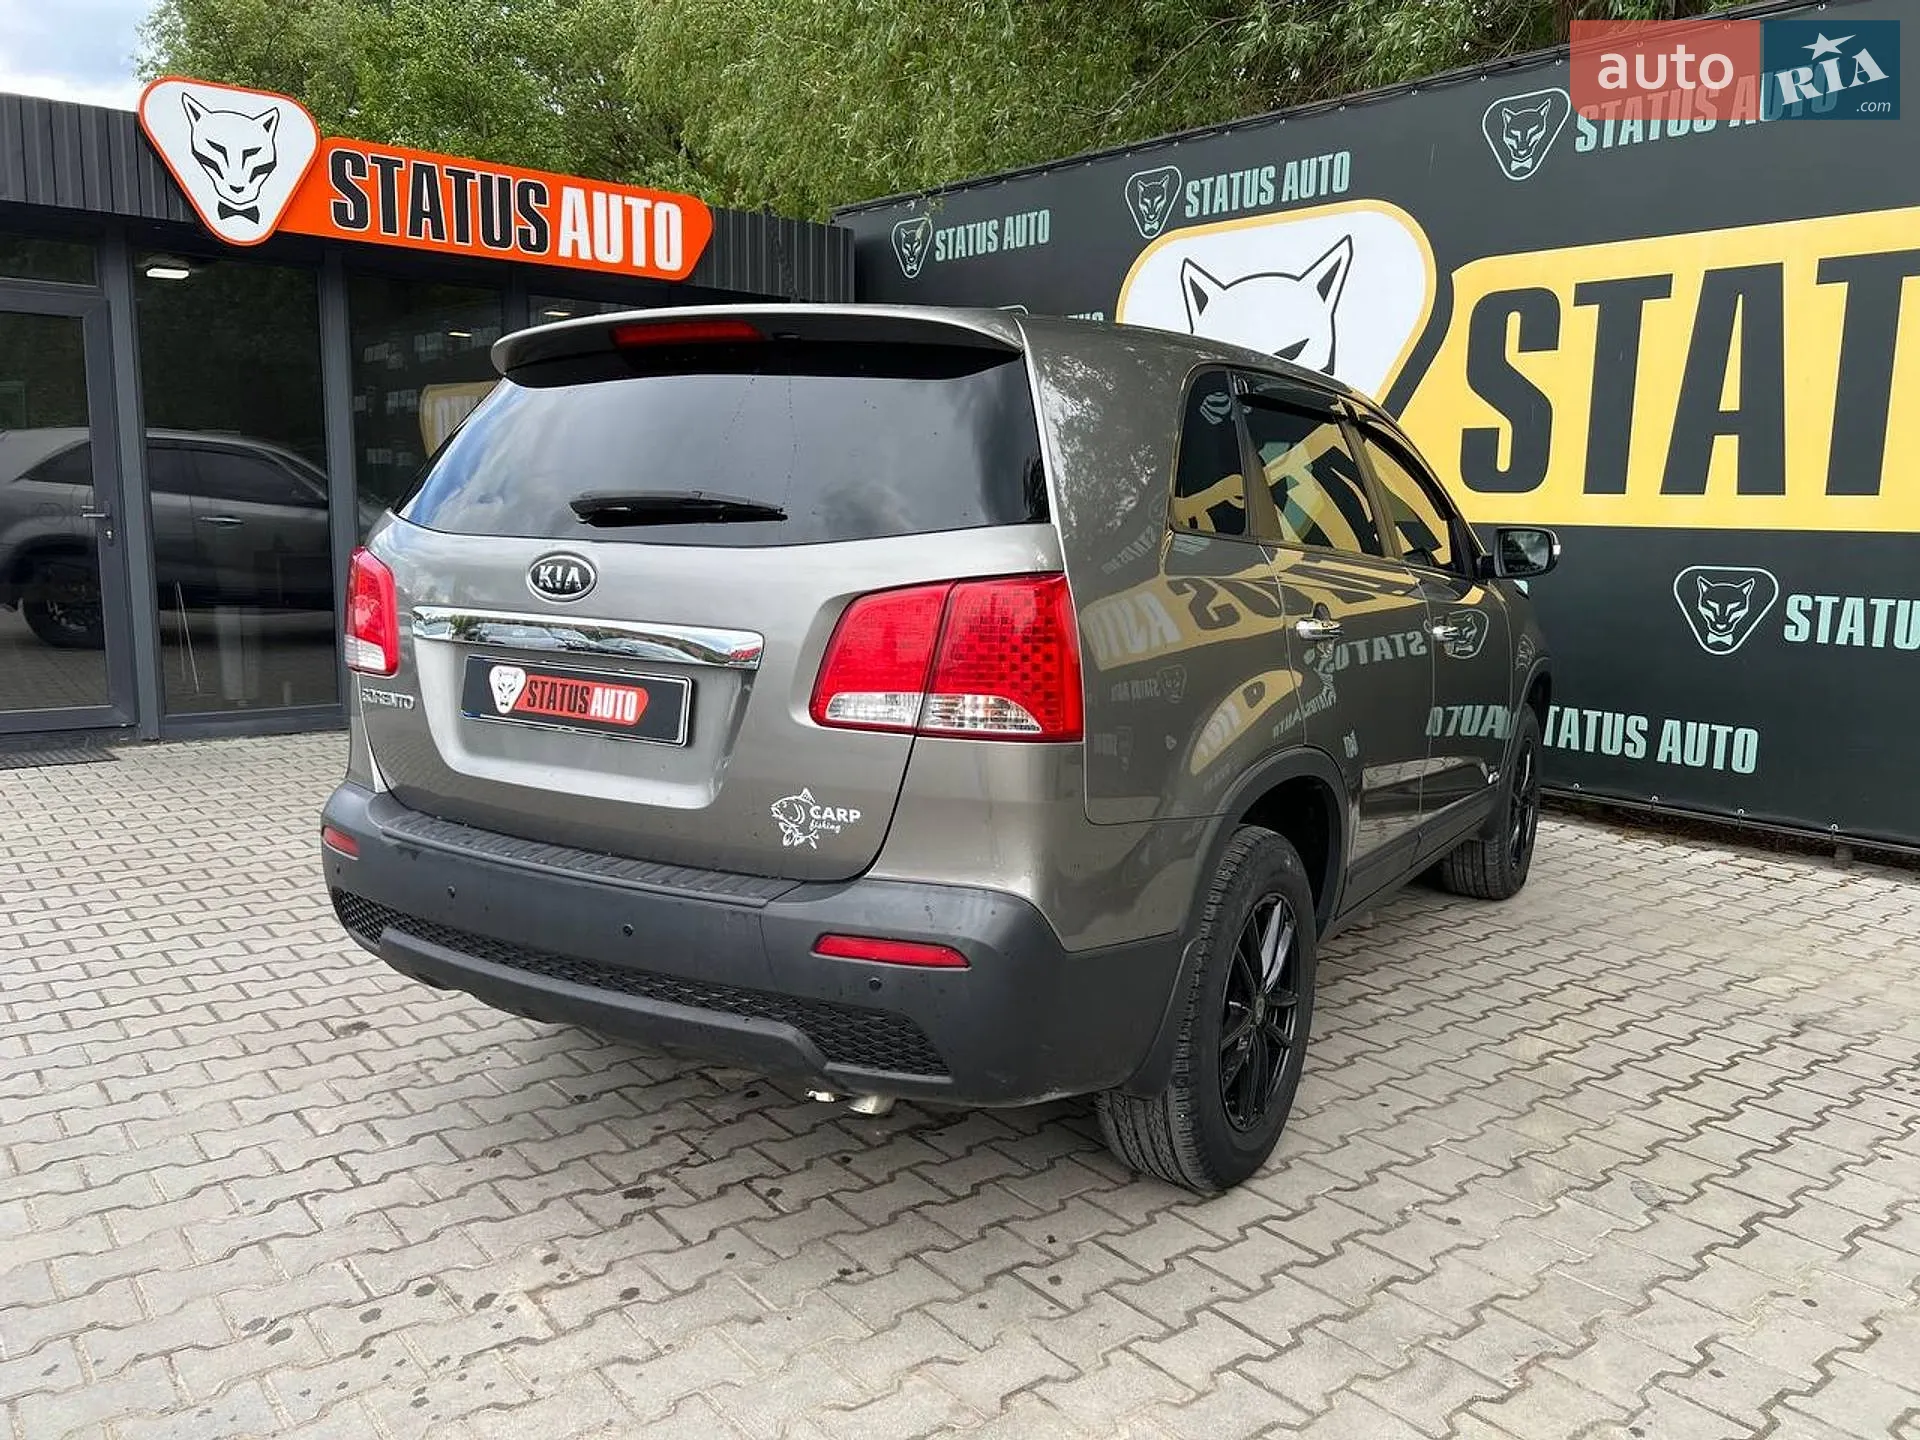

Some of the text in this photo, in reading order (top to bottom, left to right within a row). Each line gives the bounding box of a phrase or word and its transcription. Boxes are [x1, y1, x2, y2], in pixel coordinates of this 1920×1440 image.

[1574, 83, 1720, 153] STATUS
[328, 148, 684, 271] STATUS AUTO
[1185, 151, 1351, 219] STATUS AUTO
[934, 209, 1051, 262] STATUS AUTO
[1460, 248, 1920, 496] STAT
[538, 565, 582, 590] KIA
[527, 680, 638, 722] STATUS AUTO
[1657, 718, 1760, 774] AUTO
[809, 805, 861, 823] CARP
